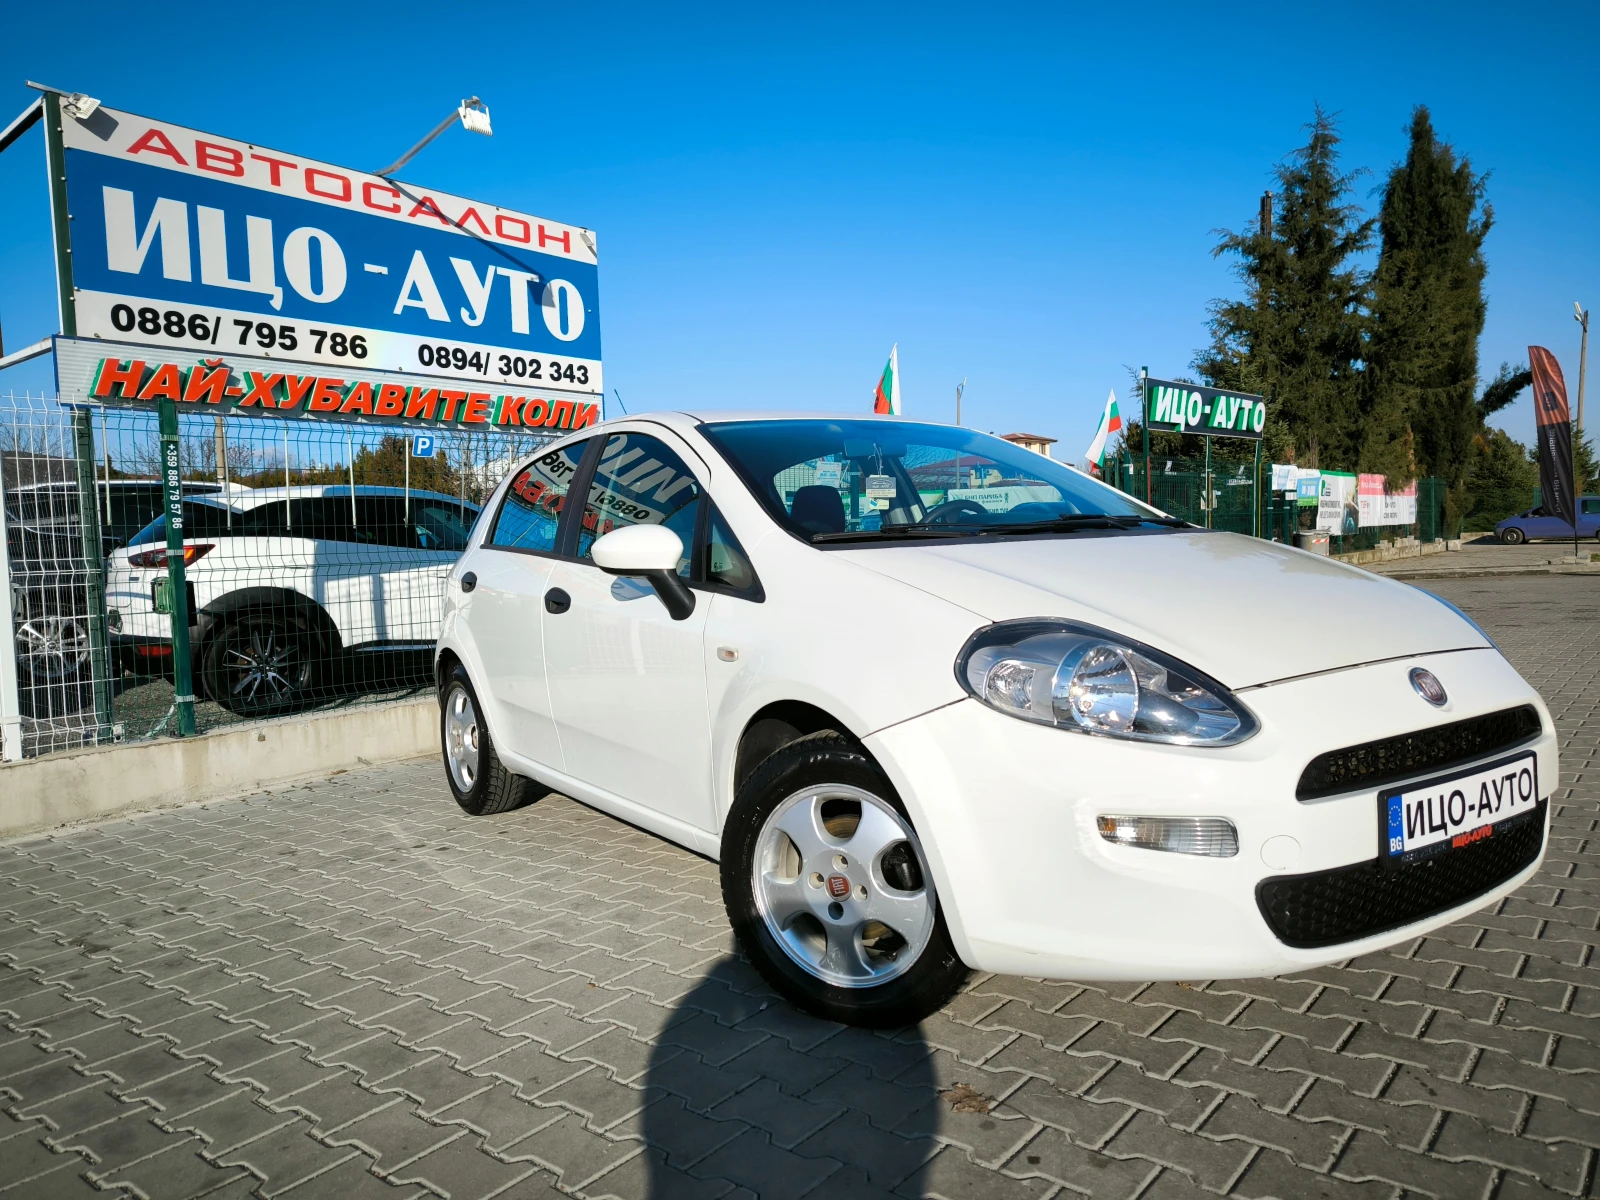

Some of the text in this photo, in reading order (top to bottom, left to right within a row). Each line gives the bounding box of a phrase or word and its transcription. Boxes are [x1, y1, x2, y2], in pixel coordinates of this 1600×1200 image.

[126, 128, 570, 253] АВТОСАЛОН
[110, 303, 368, 359] 0886/ 795 786
[418, 343, 589, 385] 0894/ 302 343
[92, 357, 598, 430] НАЙ-ХУБАВИТЕ КОЛИ
[1153, 385, 1266, 433] ИЦО-АУТО
[416, 439, 430, 454] P
[166, 443, 183, 529] +359 886 79 57 86
[1406, 767, 1532, 839] ИЦО-АУТО
[1389, 838, 1402, 853] BG
[1452, 824, 1493, 848] ИЦО-АУТО
[831, 878, 846, 895] FIAT
